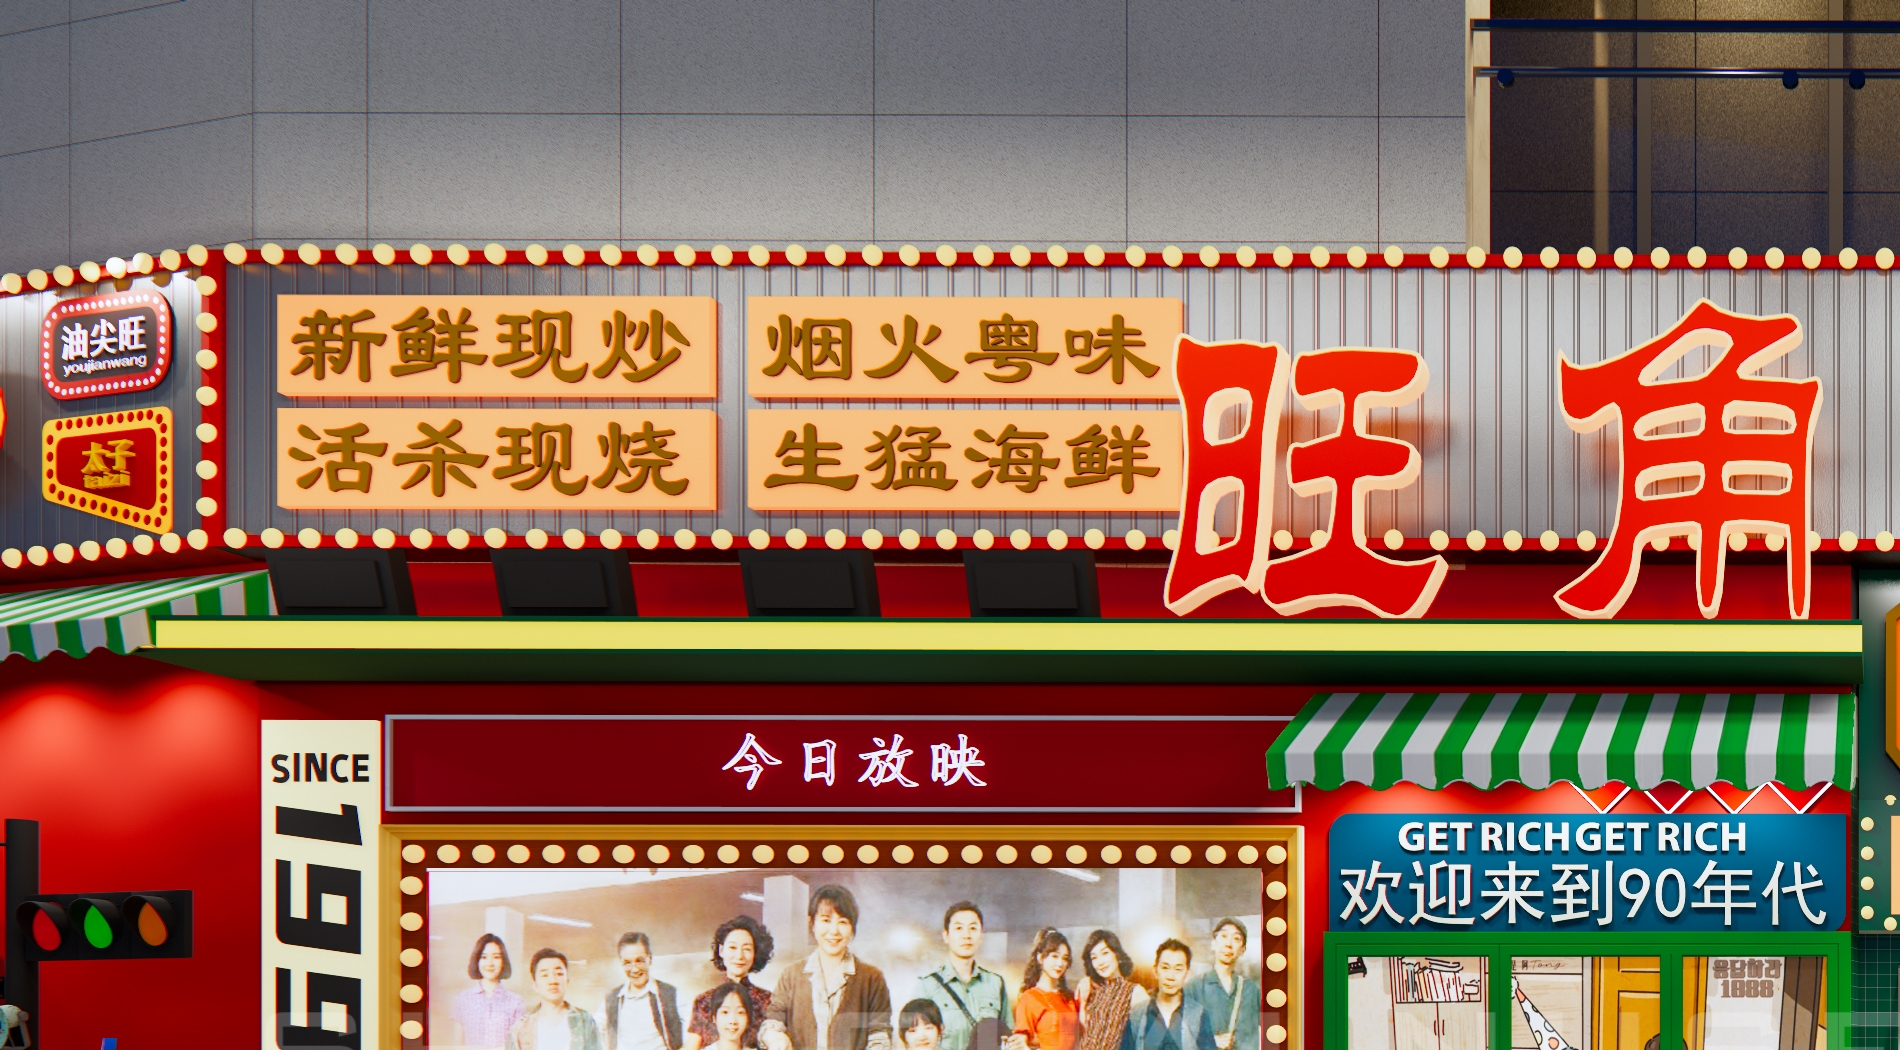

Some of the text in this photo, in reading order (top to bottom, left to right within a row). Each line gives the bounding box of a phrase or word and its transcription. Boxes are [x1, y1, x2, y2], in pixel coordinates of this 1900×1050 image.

[61, 315, 147, 361] 油尖旺
[63, 354, 147, 377] youjianwang
[289, 307, 691, 383] 新鲜现炒
[761, 313, 1161, 384] 烟火粤味
[81, 439, 136, 474] 太子
[288, 419, 691, 497] 活杀现烧
[763, 422, 1161, 494] 生猛海鲜
[1164, 298, 1823, 619] 旺角
[271, 753, 370, 783] SINCE
[722, 732, 987, 791] 今日放映
[1398, 821, 1473, 852] GET
[1663, 821, 1746, 852] RICH
[1340, 859, 1827, 926] 欢迎来到90年代
[1720, 980, 1774, 998] 1988
